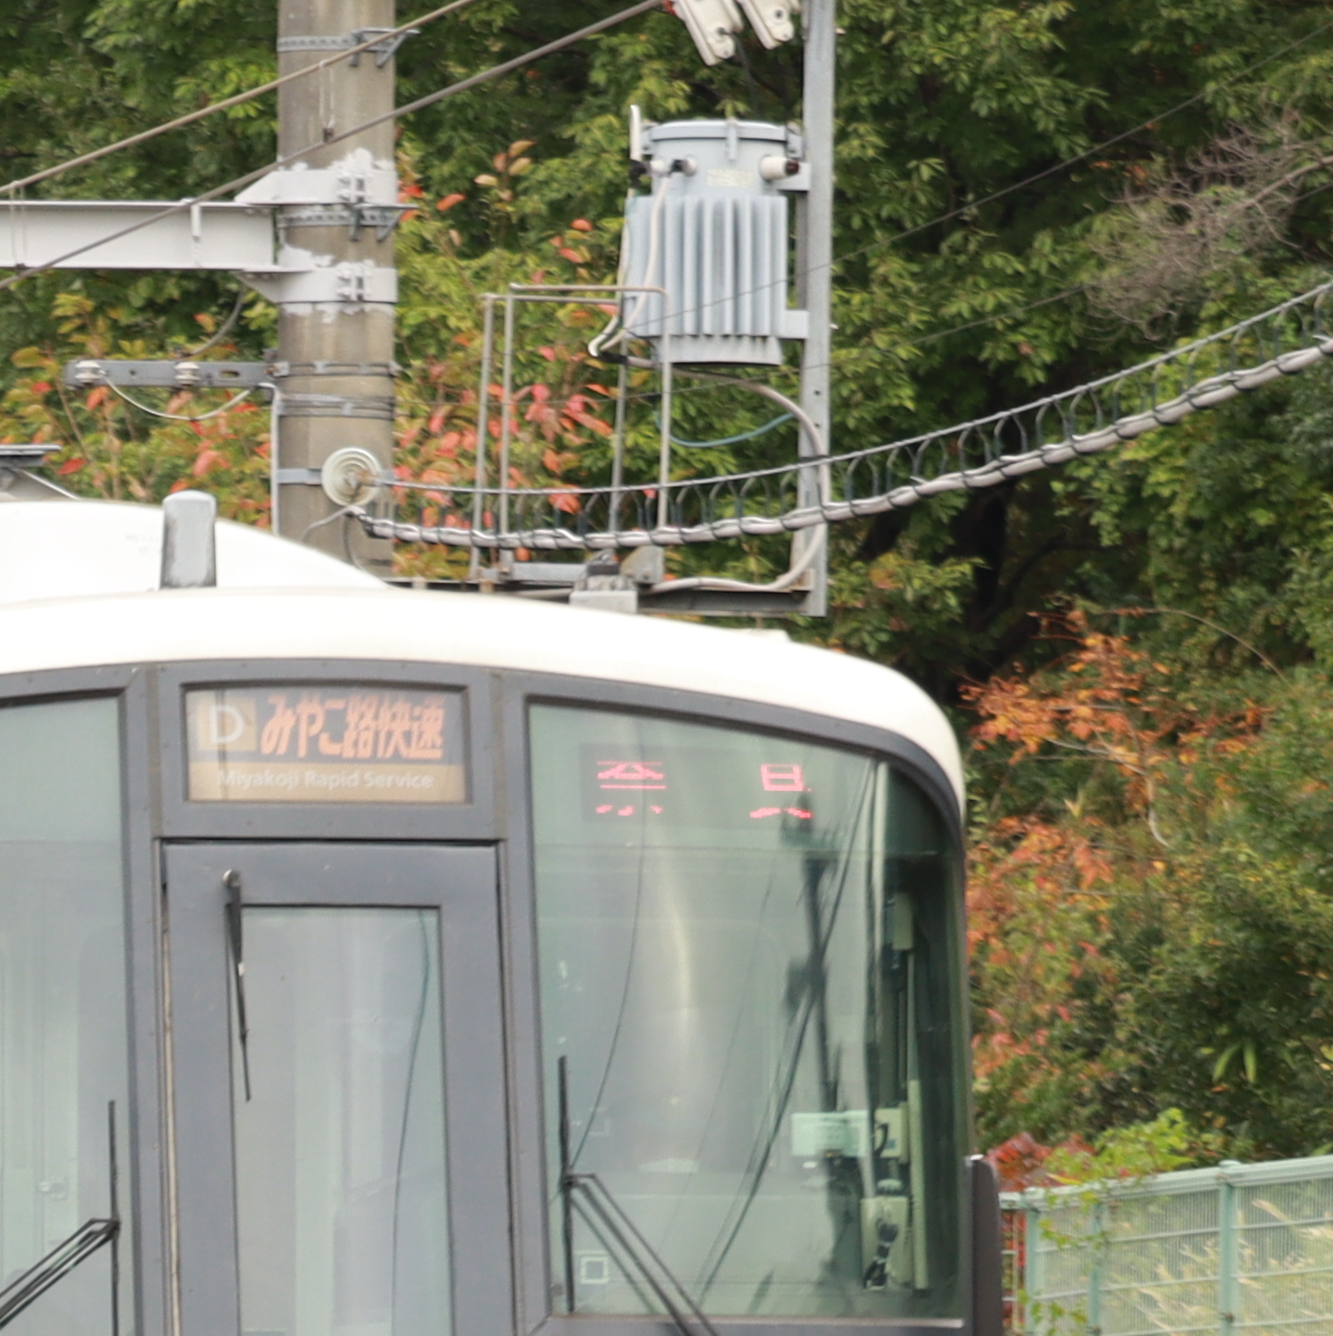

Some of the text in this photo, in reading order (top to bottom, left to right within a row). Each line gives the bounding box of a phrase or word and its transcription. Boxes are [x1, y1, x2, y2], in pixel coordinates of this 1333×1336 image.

[209, 703, 244, 744] D
[219, 769, 434, 790] Miyakoji Rapid Service
